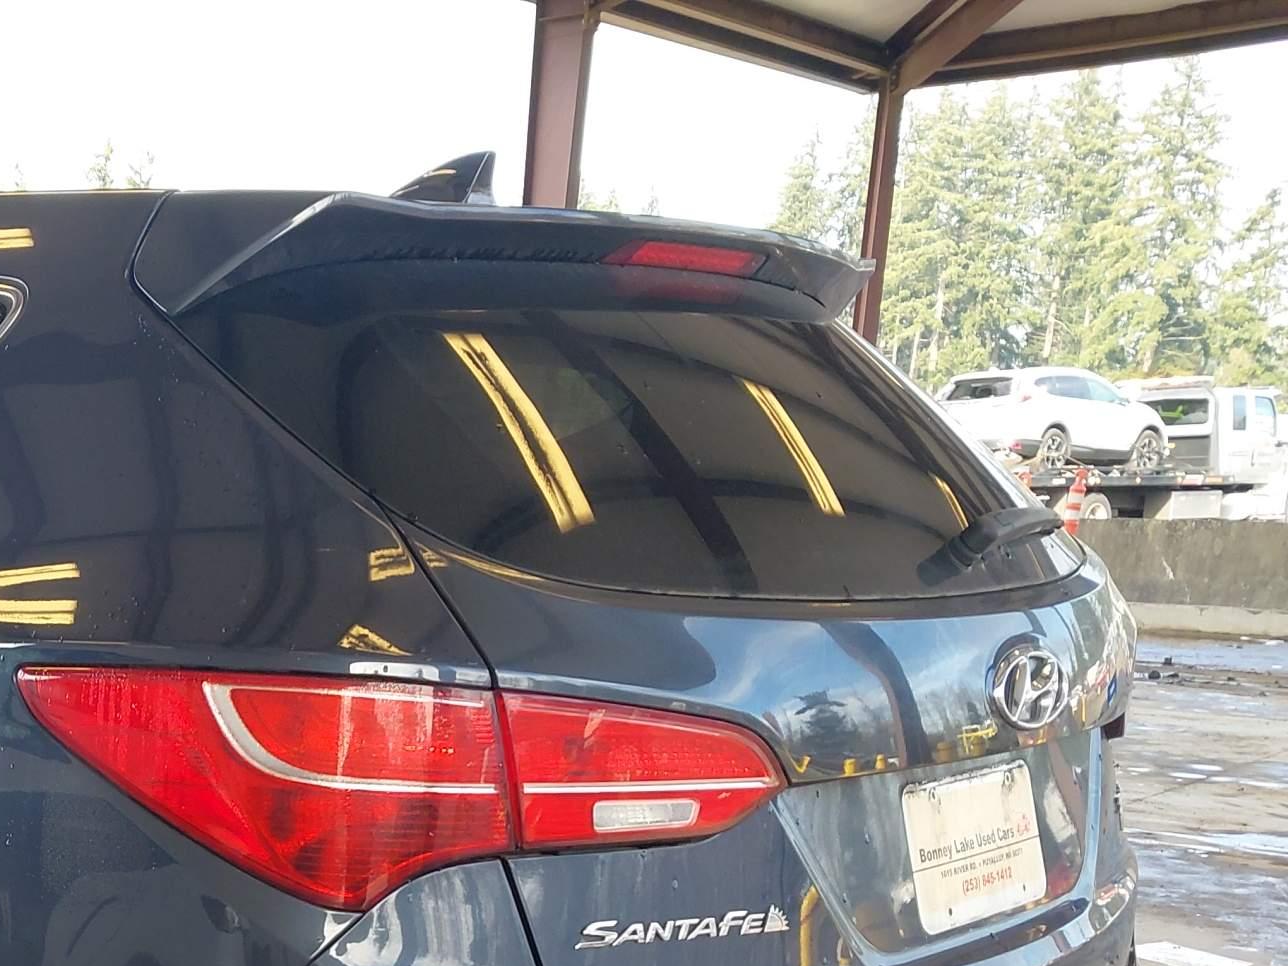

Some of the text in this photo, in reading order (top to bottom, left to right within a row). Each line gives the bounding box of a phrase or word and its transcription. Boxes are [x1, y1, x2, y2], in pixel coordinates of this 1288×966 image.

[919, 827, 1015, 863] Bonney Lake Used Cars
[962, 866, 1013, 896] (253) 845-1412
